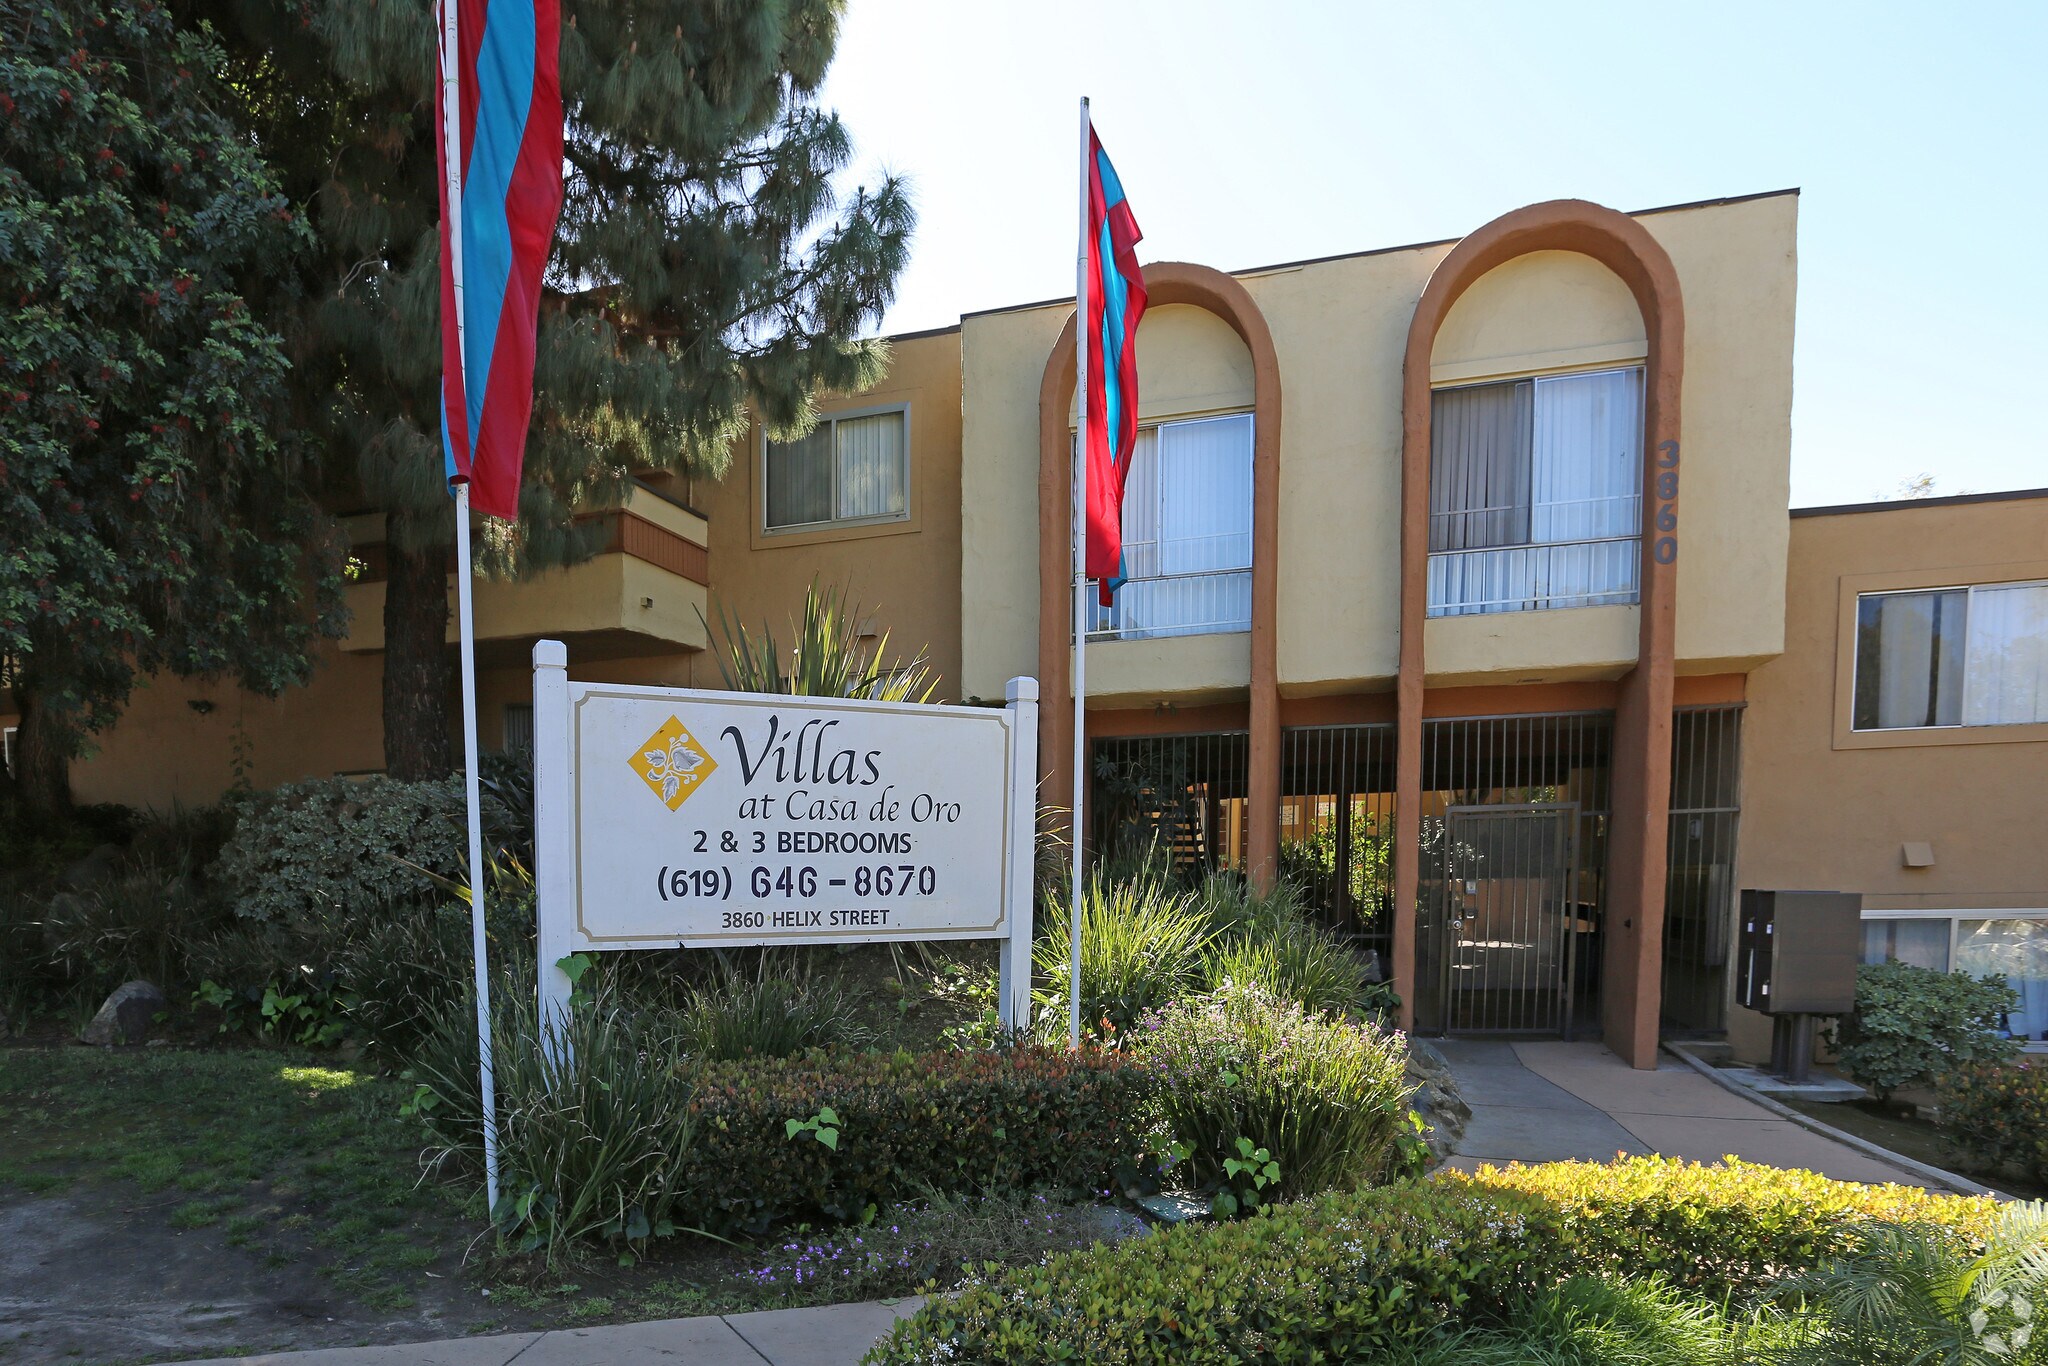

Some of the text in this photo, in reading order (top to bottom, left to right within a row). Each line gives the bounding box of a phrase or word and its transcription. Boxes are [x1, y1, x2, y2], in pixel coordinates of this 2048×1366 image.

[1654, 439, 1680, 565] 3860
[720, 715, 882, 786] Villas
[738, 785, 961, 823] at Casa de Oro
[693, 831, 912, 854] 2 & 3 BEDROOMS
[657, 866, 732, 901] (619)
[722, 910, 890, 928] 3860 HELIX STREET
